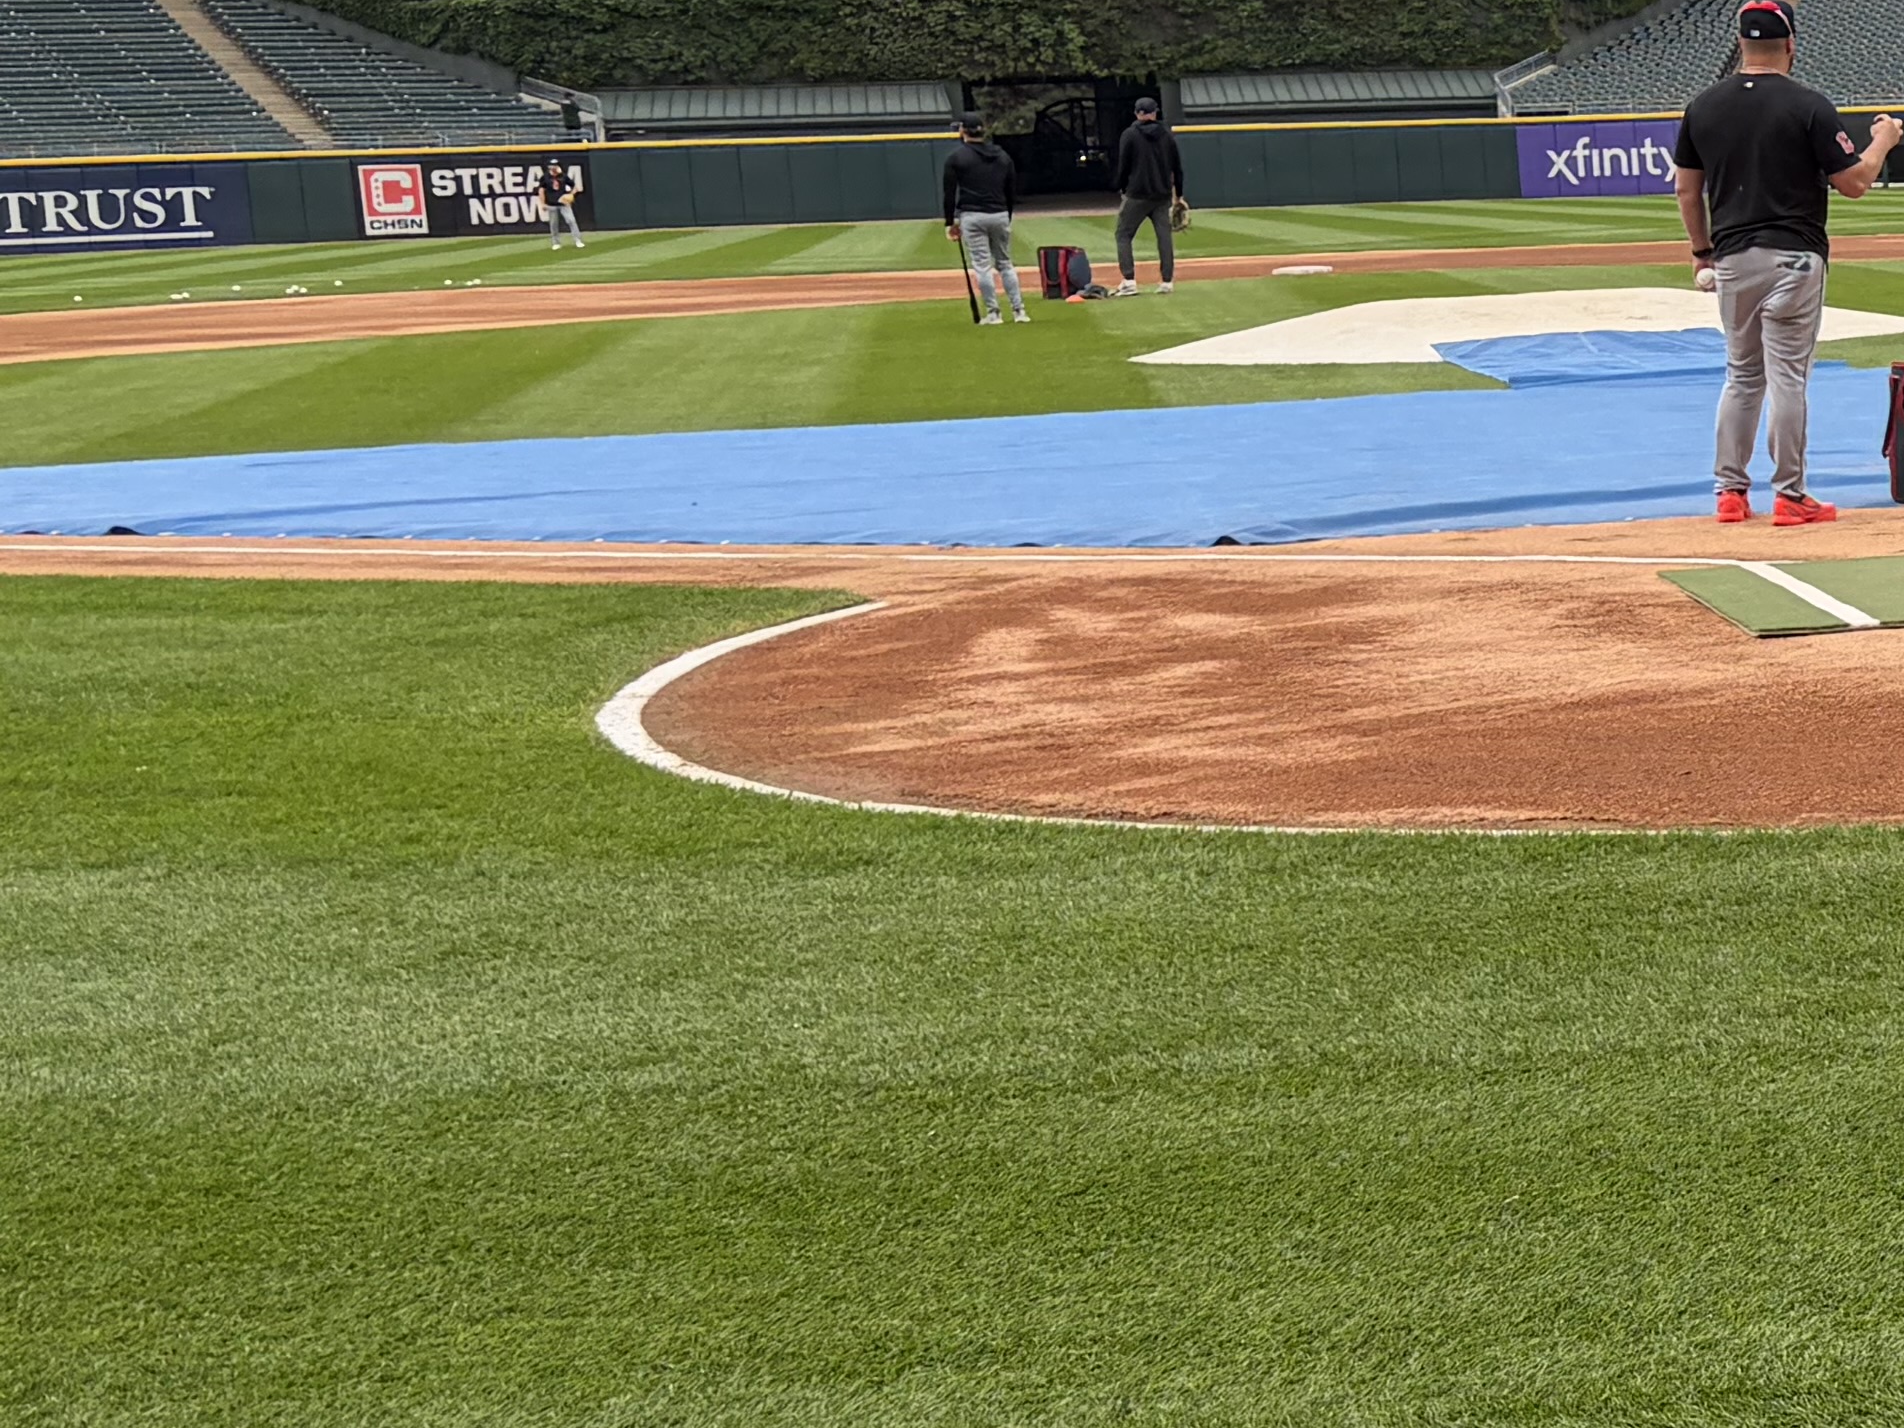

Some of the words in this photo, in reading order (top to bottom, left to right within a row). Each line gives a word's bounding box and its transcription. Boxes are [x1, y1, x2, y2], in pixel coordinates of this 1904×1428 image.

[1546, 135, 1677, 186] xfinity
[0, 186, 212, 233] TRUST
[369, 217, 423, 231] CHSN
[469, 195, 550, 225] NOW
